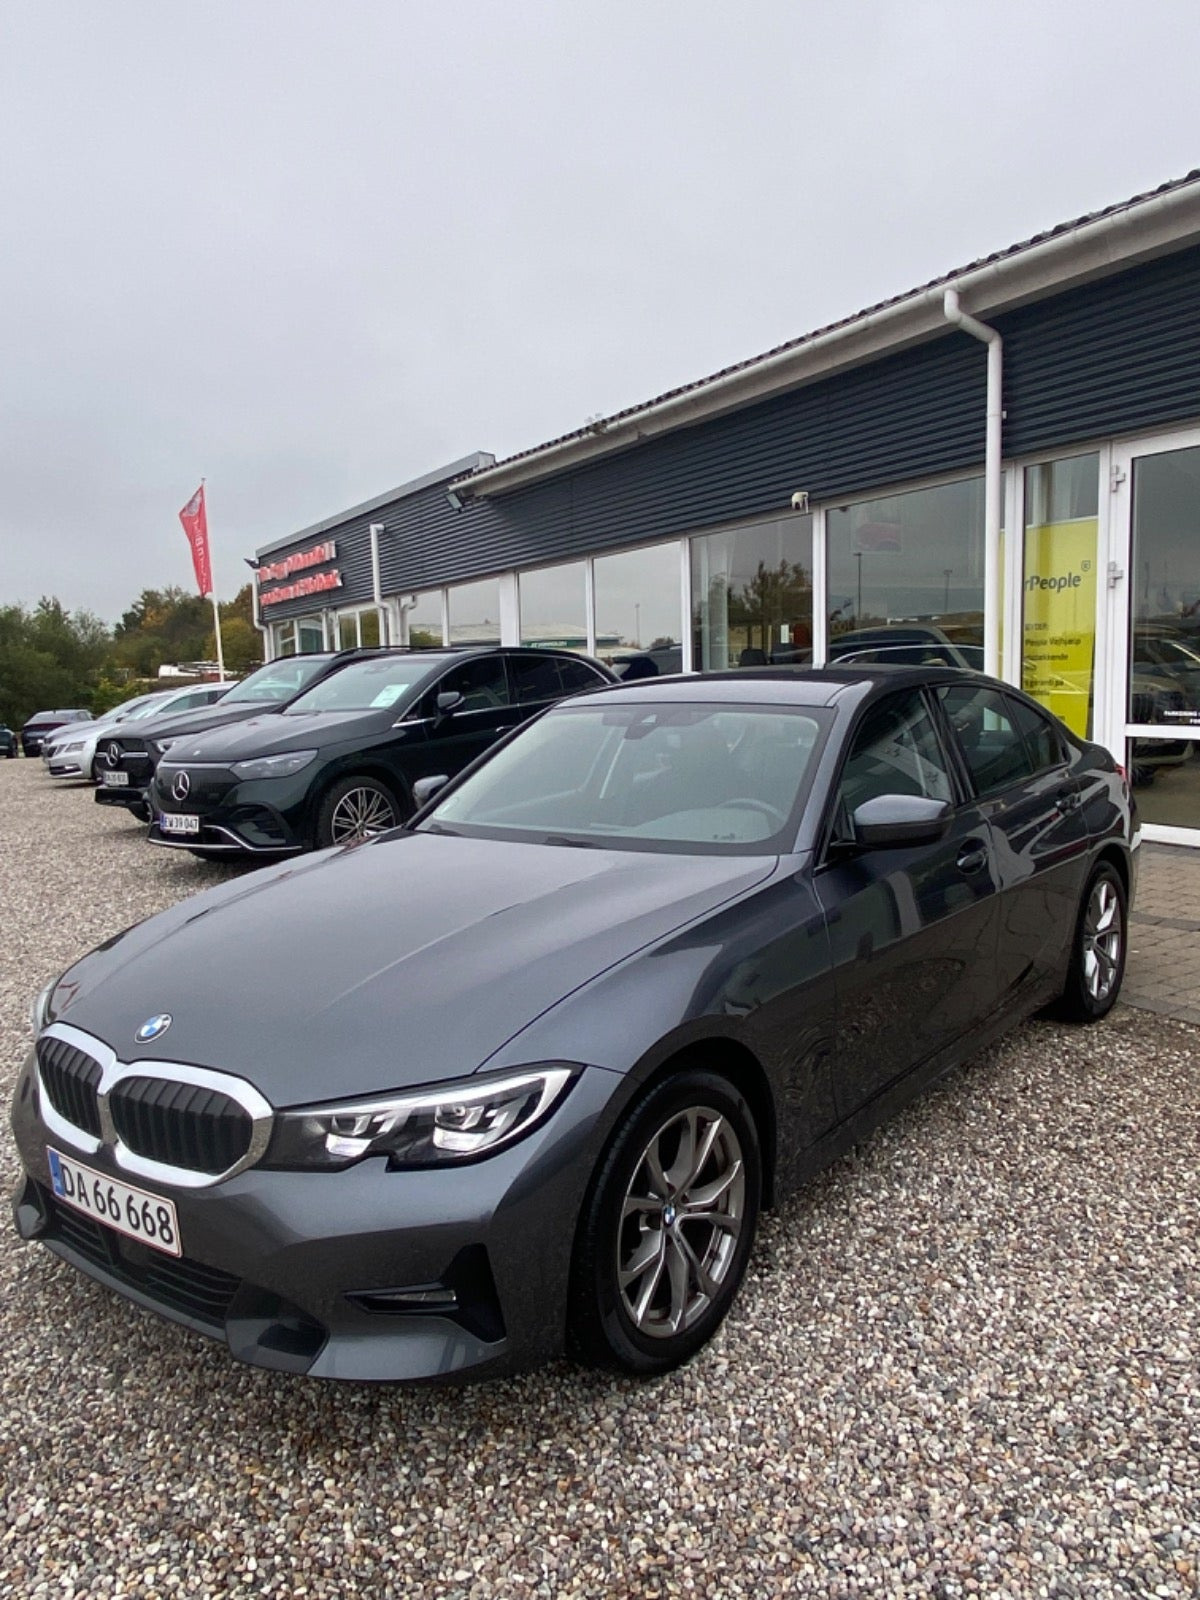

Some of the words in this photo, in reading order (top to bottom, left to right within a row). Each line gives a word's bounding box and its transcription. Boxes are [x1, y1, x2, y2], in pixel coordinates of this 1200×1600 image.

[60, 1163, 91, 1208] DA
[93, 1179, 121, 1222] 66
[126, 1194, 174, 1245] 668
